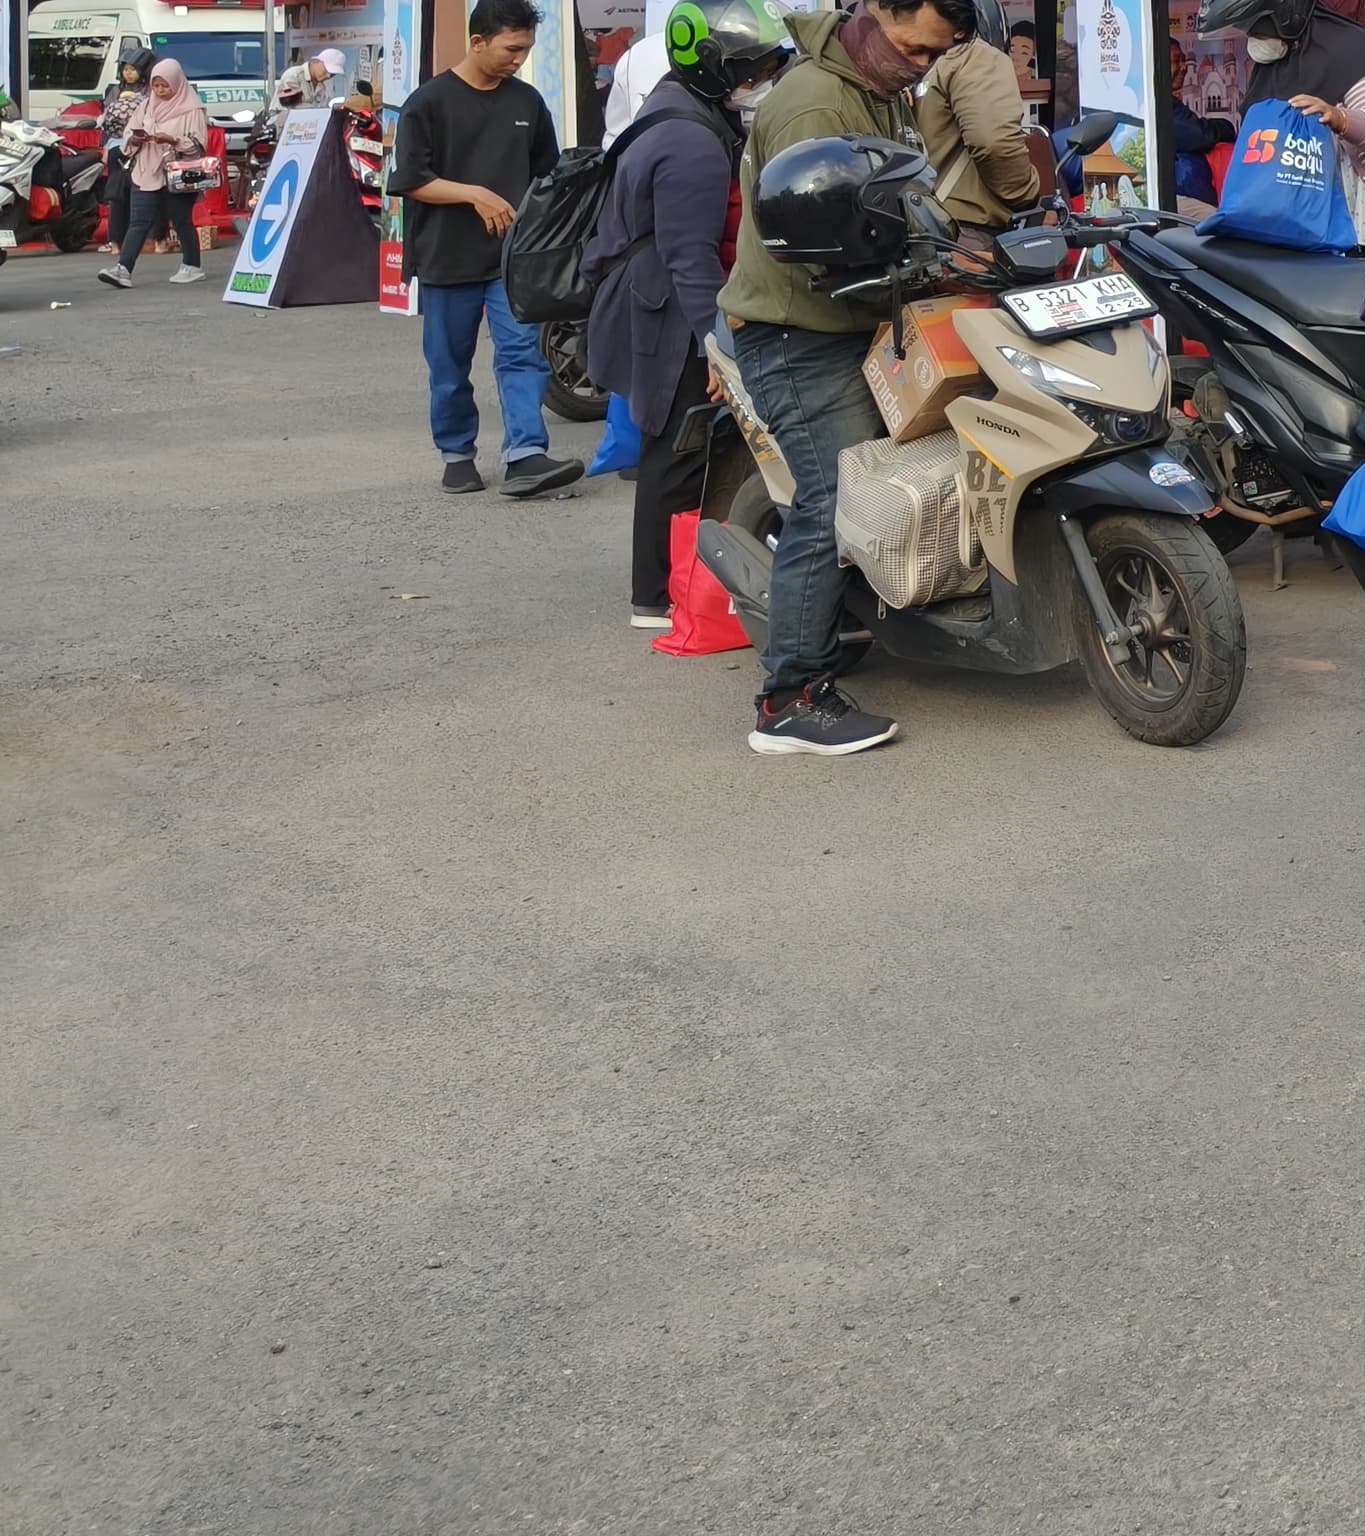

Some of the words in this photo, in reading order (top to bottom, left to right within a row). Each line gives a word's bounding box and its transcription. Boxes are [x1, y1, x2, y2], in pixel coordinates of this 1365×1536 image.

[53, 17, 91, 31] AMBULANCE
[1284, 133, 1323, 156] bank
[1280, 150, 1324, 175] saqu
[1012, 296, 1030, 313] B
[1035, 285, 1088, 308] 5321
[1092, 275, 1132, 297] KHA
[867, 358, 904, 434] amidis
[976, 415, 1021, 438] HONDA
